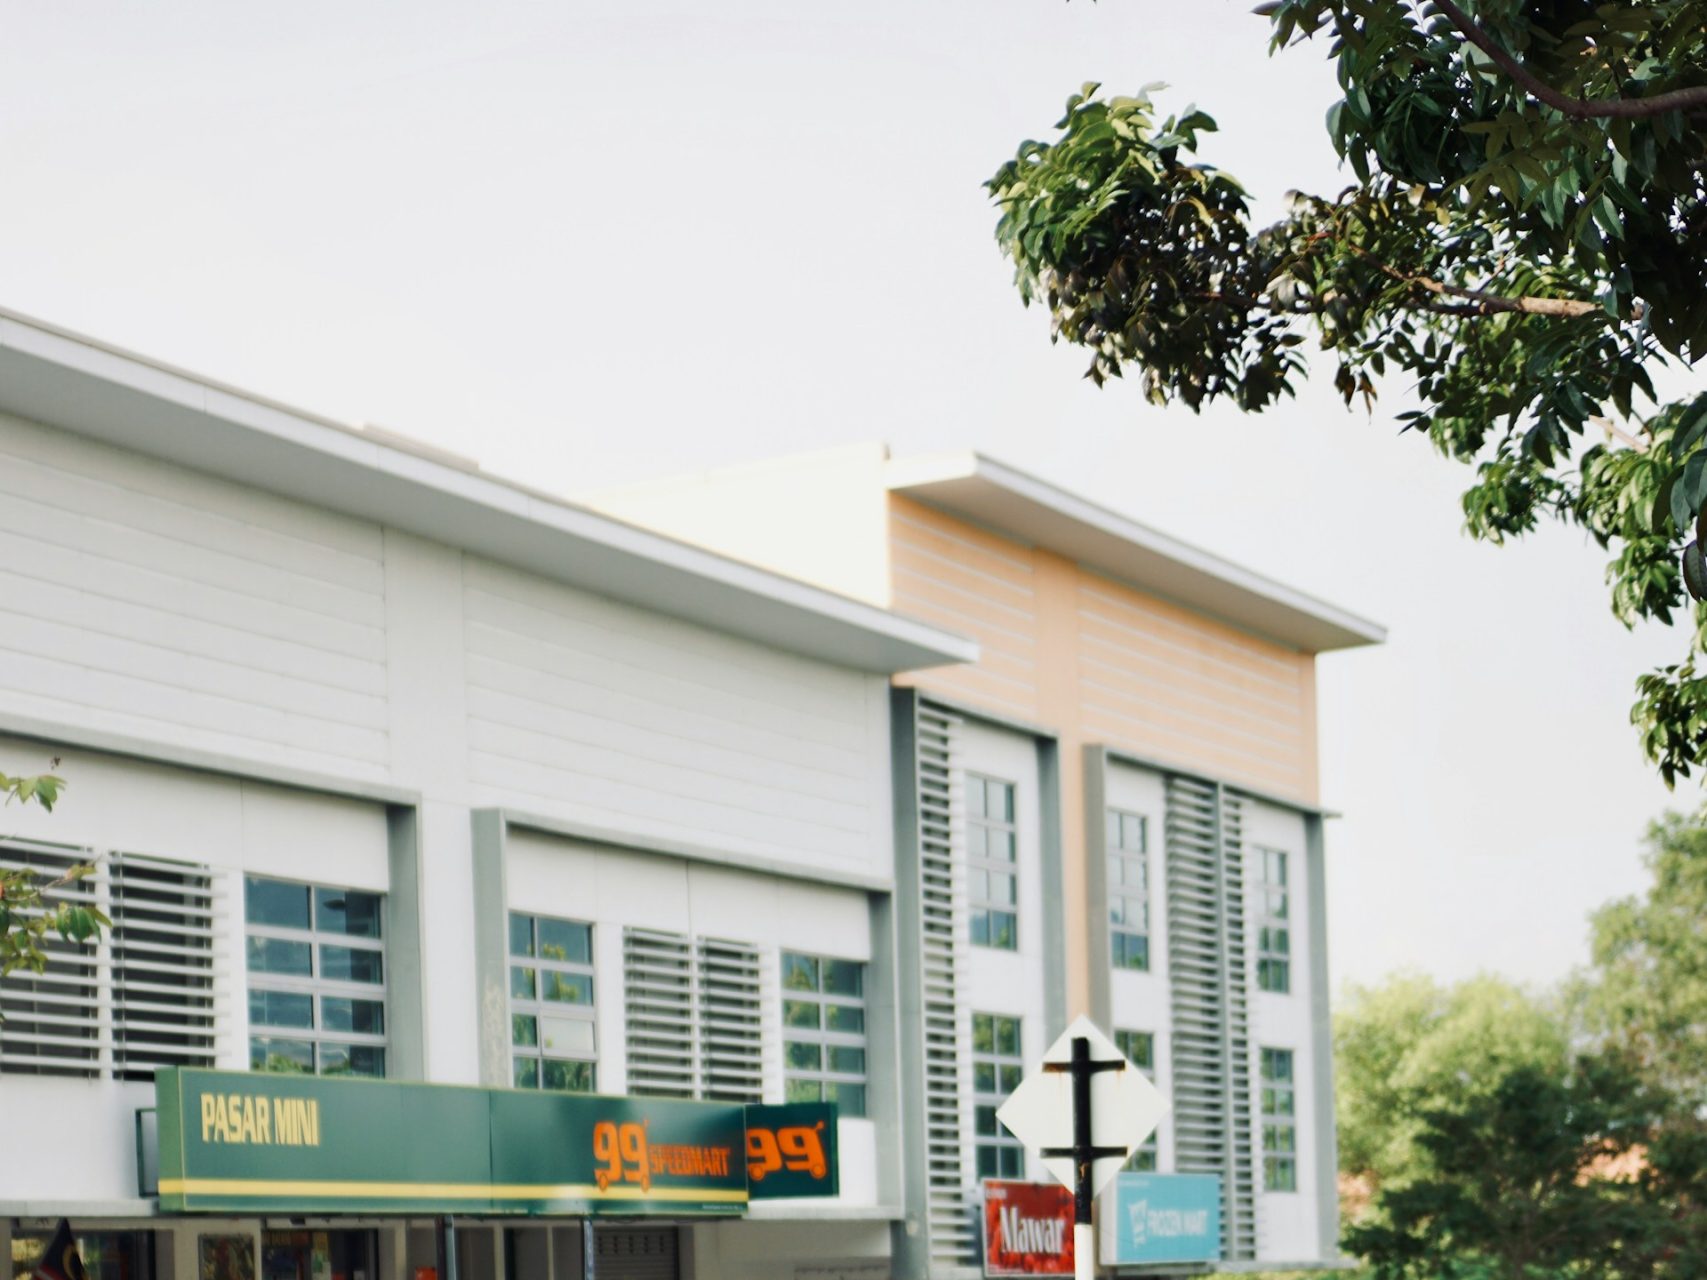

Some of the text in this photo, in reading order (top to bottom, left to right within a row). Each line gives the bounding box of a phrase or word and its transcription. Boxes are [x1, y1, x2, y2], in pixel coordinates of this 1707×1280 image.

[201, 1093, 320, 1146] PASAR MINI
[593, 1119, 651, 1191] 99
[747, 1126, 827, 1180] 99
[1000, 1205, 1065, 1254] Mawar
